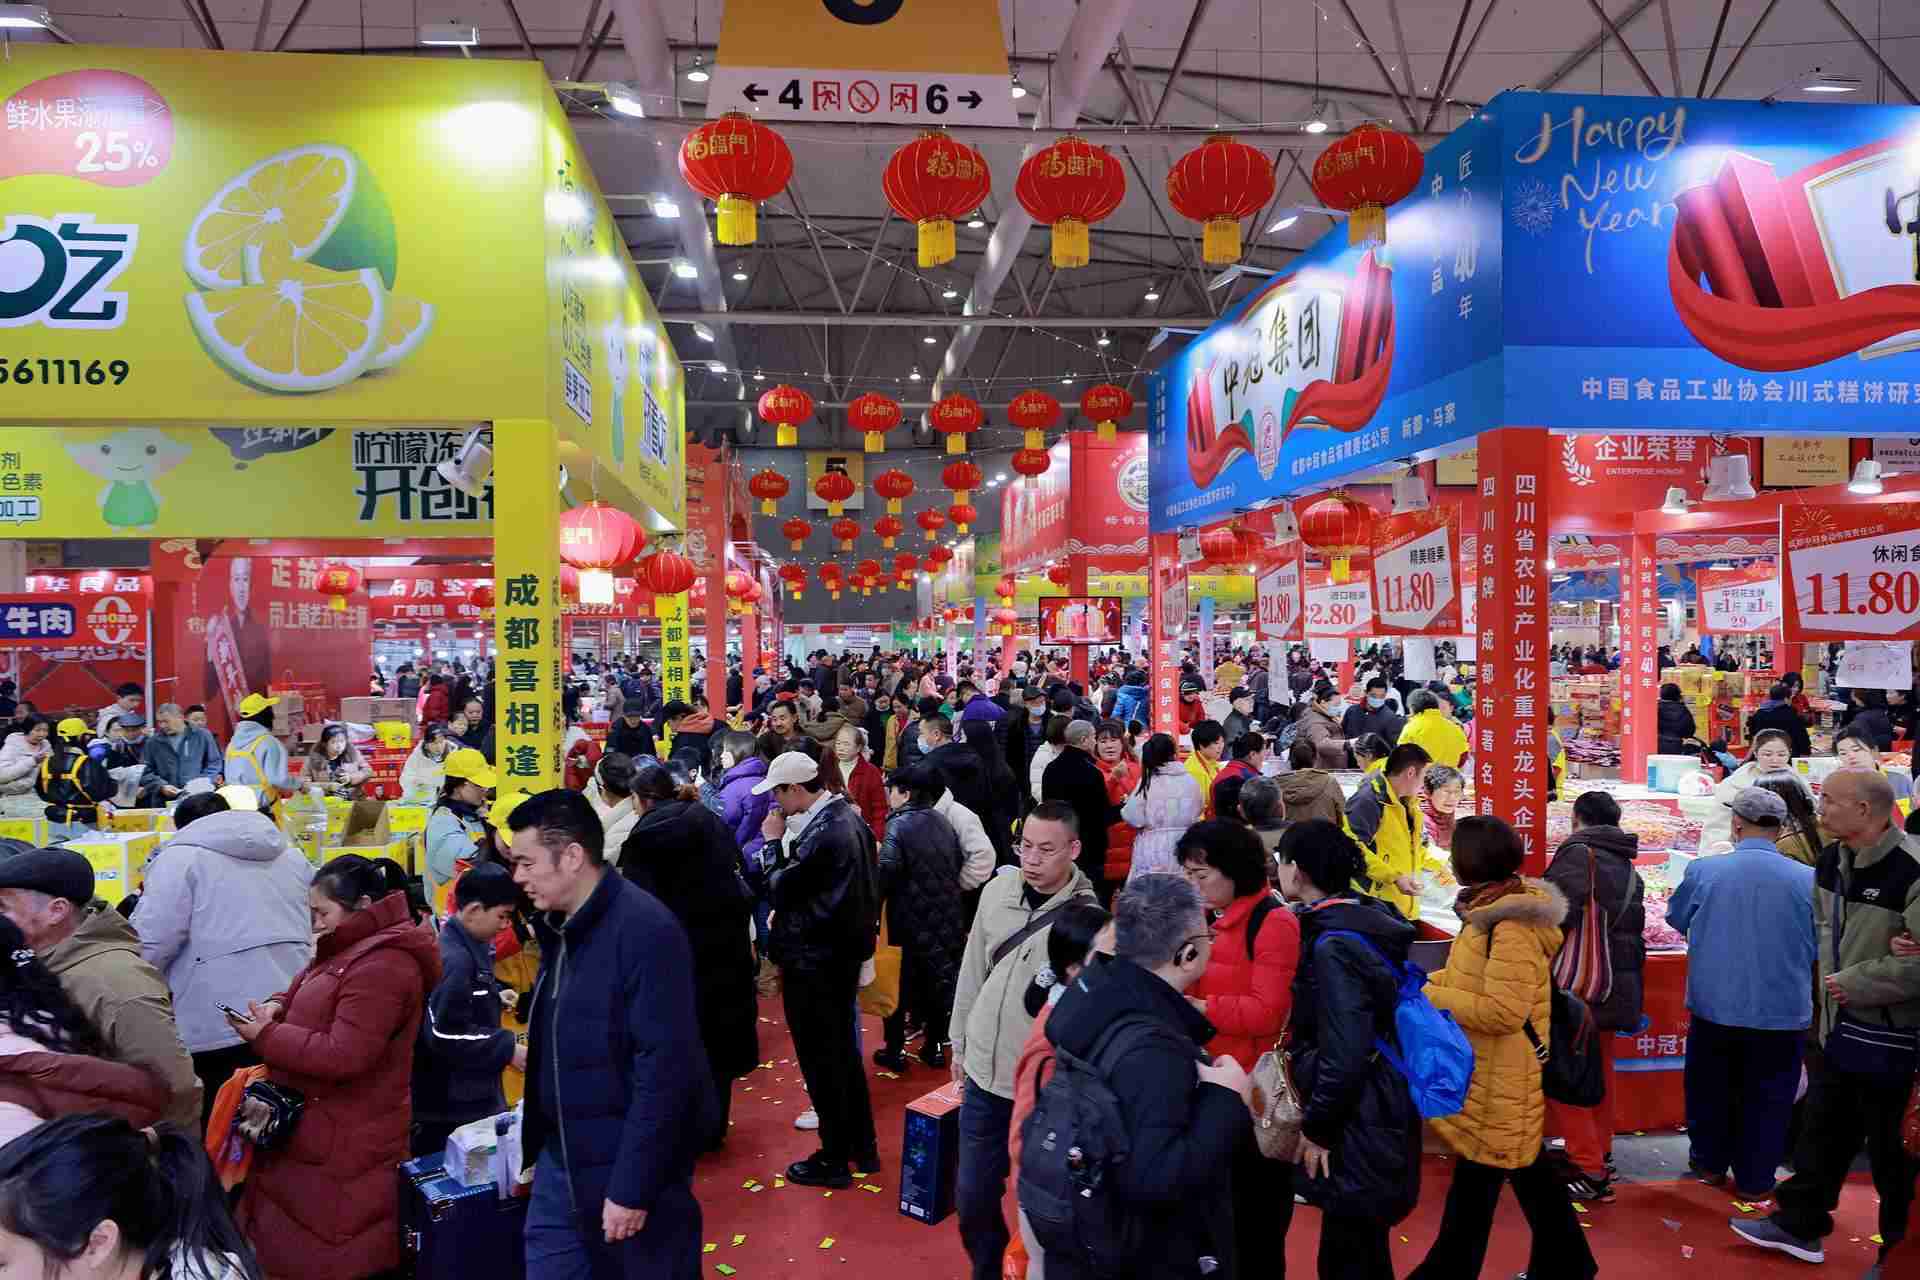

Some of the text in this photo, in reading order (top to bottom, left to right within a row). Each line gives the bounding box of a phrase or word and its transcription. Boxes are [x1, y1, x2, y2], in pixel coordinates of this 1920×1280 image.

[778, 79, 949, 115] 4 6
[75, 131, 160, 173] 25%
[1514, 105, 1687, 169] Happy
[1560, 159, 1658, 210] New
[1578, 200, 1679, 275] Year
[352, 431, 493, 464] 柠檬冻
[1594, 435, 1697, 463] 企业荣誉
[1261, 593, 1291, 625] 21.80
[1383, 571, 1435, 613] 11.80
[1806, 571, 1919, 616] 11.80
[5, 606, 74, 635] 牛肉
[504, 574, 541, 777] 成都喜相逢
